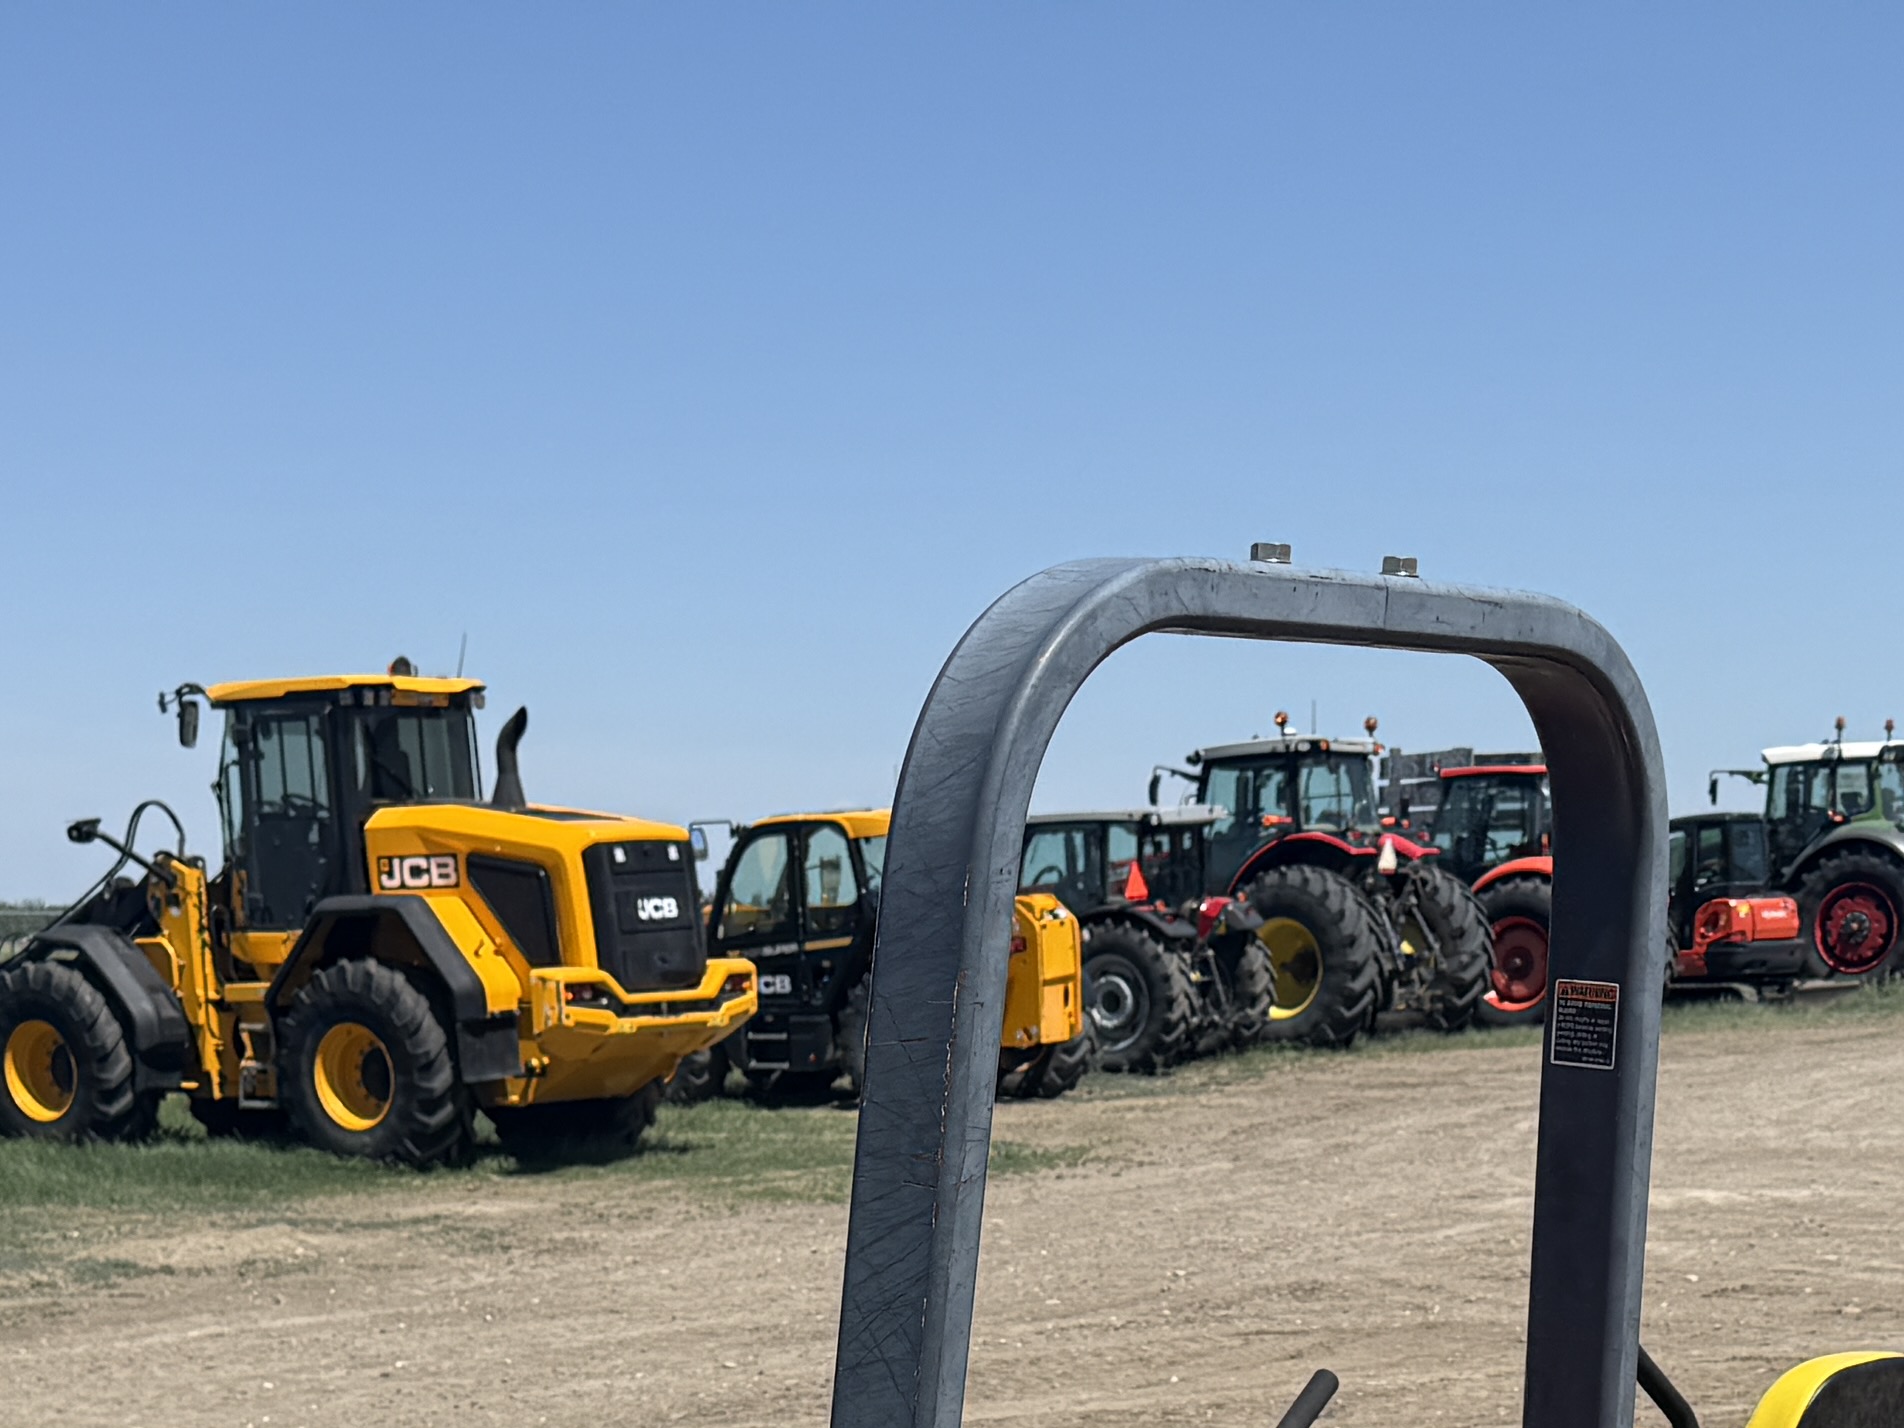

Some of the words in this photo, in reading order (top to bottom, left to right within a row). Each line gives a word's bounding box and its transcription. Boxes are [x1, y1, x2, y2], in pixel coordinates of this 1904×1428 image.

[380, 858, 458, 888] JCB
[637, 898, 678, 919] JCB
[759, 974, 792, 994] CB
